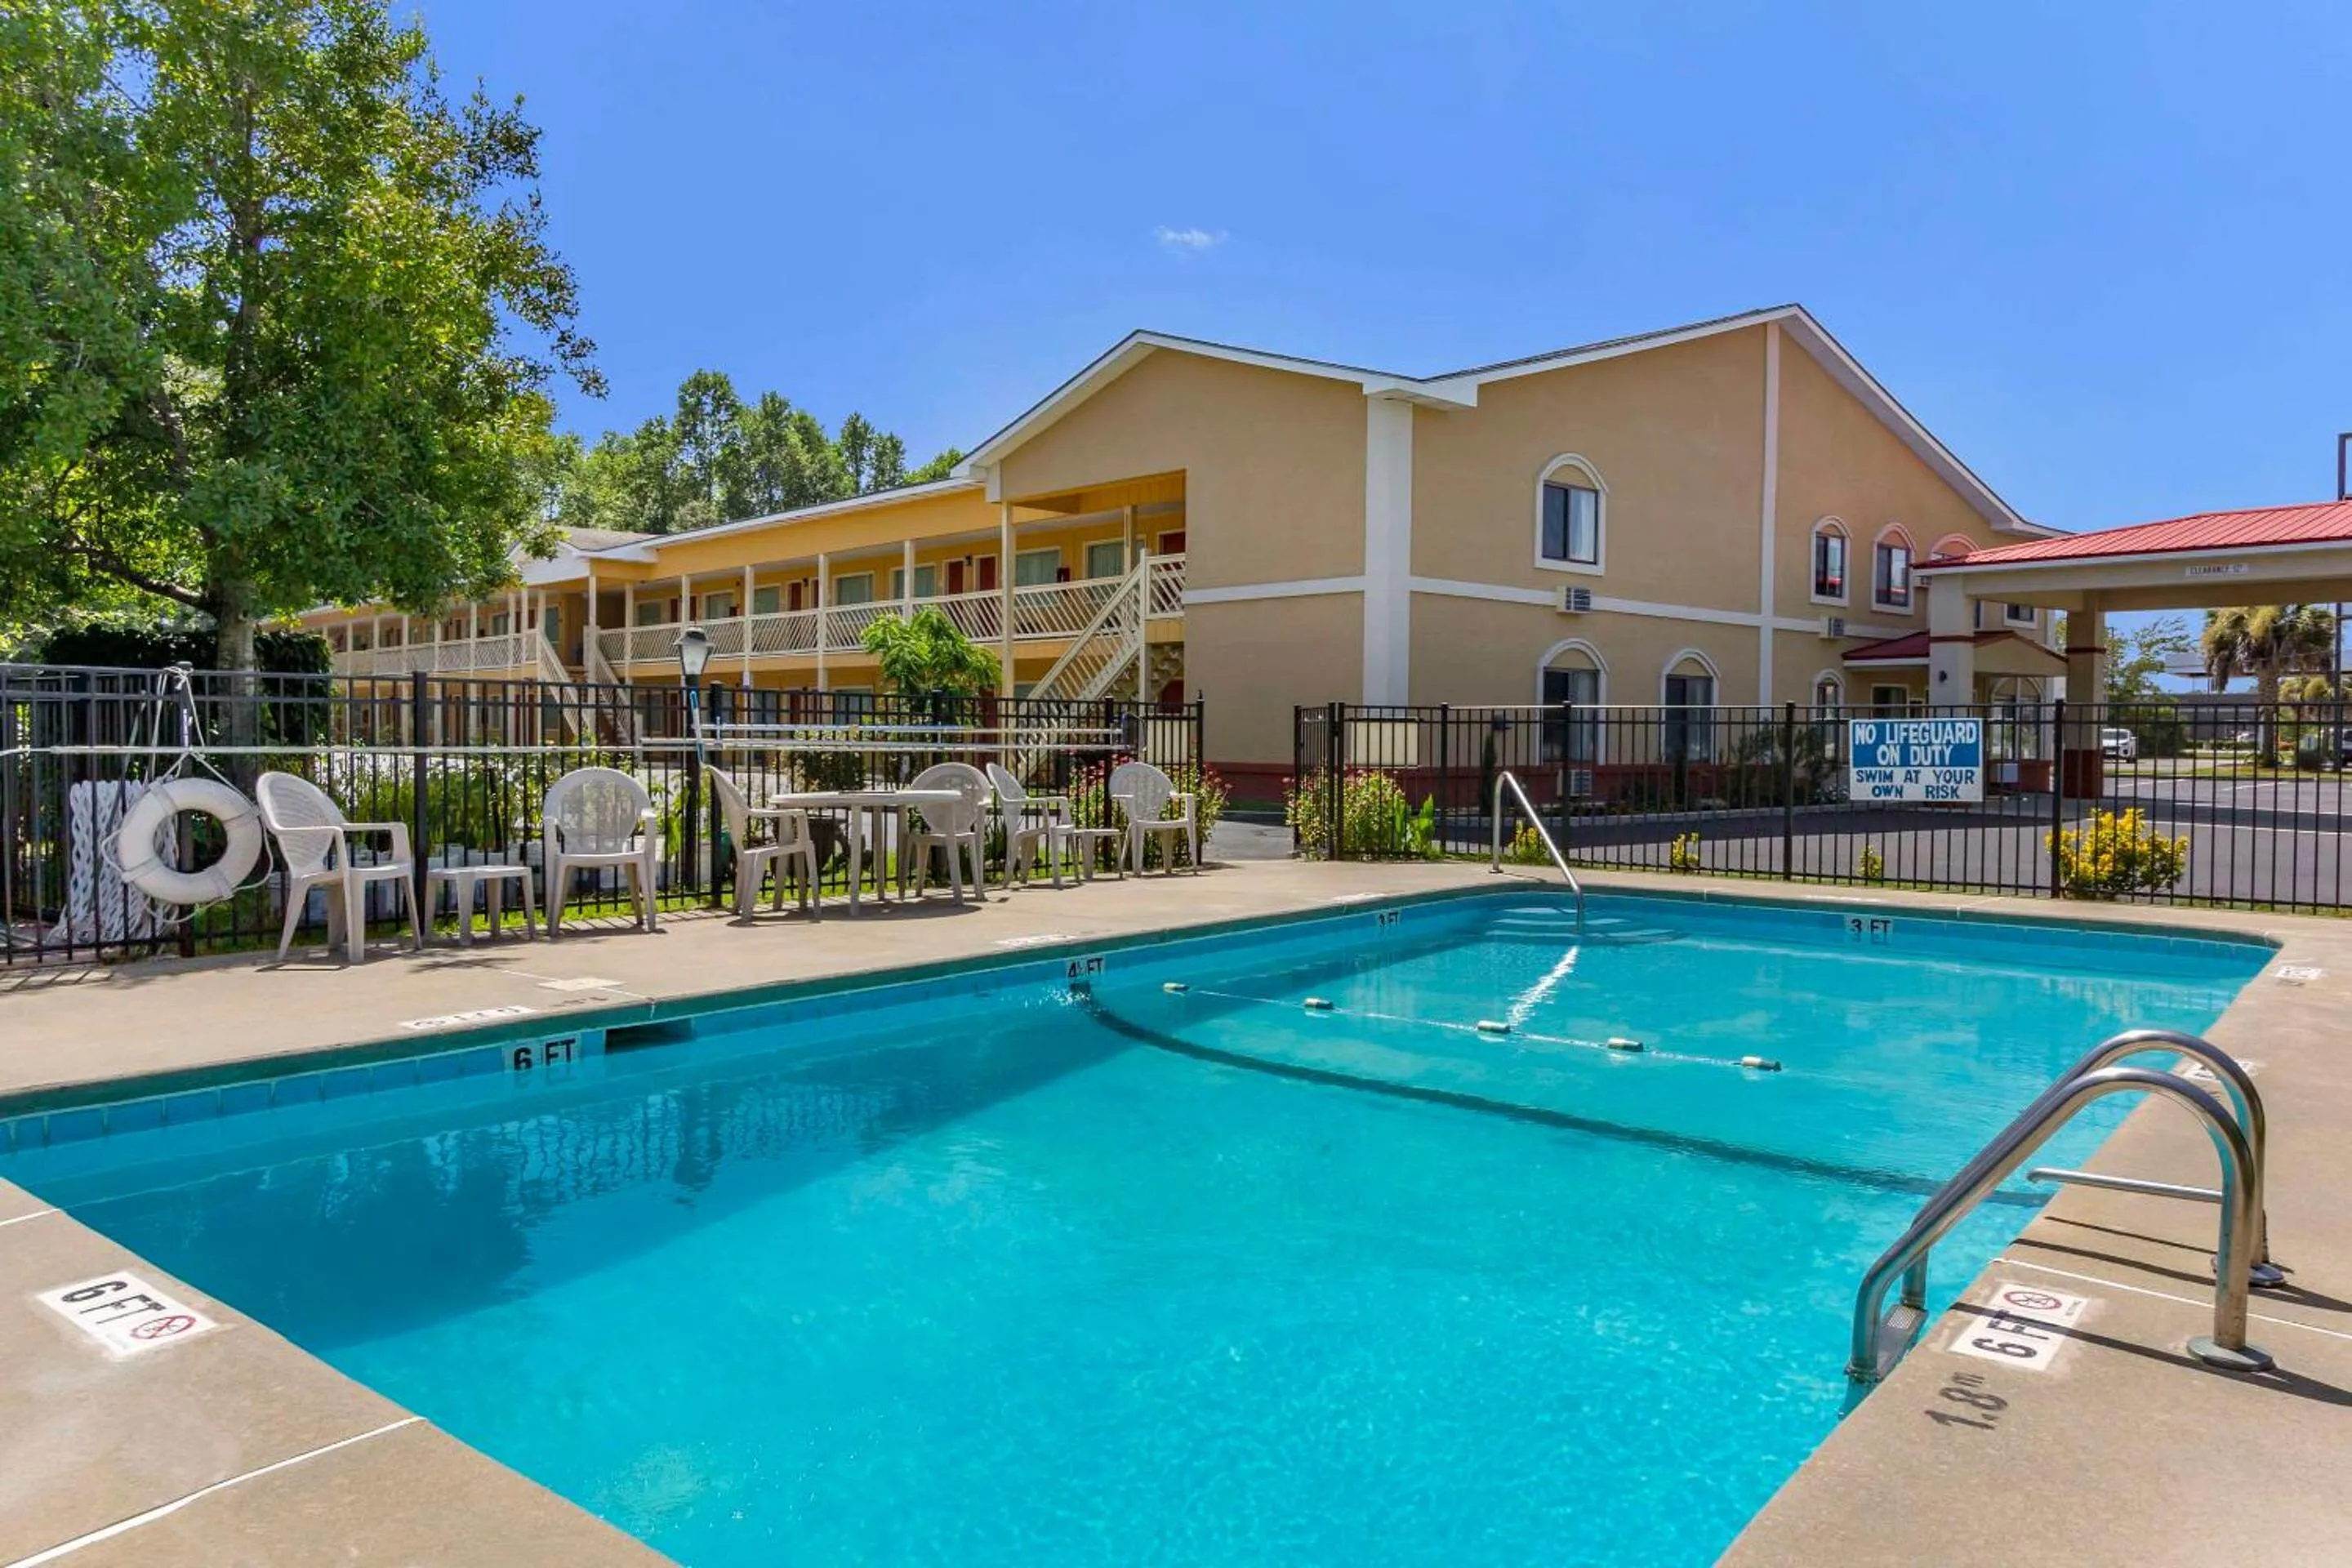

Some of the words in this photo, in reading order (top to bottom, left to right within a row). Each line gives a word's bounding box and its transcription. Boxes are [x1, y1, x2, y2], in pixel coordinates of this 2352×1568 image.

[1855, 723, 1876, 745] NO
[1886, 722, 1976, 745] LIFEGUARD
[1877, 745, 1900, 766] ON
[1909, 745, 1954, 766] DUTY
[1855, 769, 1894, 784] SWIM
[1903, 769, 1922, 784] AT
[1932, 768, 1975, 785] YOUR
[1871, 785, 1904, 799] OWN
[1925, 786, 1960, 800] RISK
[1849, 918, 1862, 933] 3
[1870, 920, 1891, 933] FT
[1087, 958, 1103, 975] FT
[513, 1047, 532, 1071] 6
[545, 1039, 576, 1067] FT
[61, 1281, 128, 1303] 6
[79, 1294, 167, 1324] FT
[1971, 1337, 2038, 1359] 6
